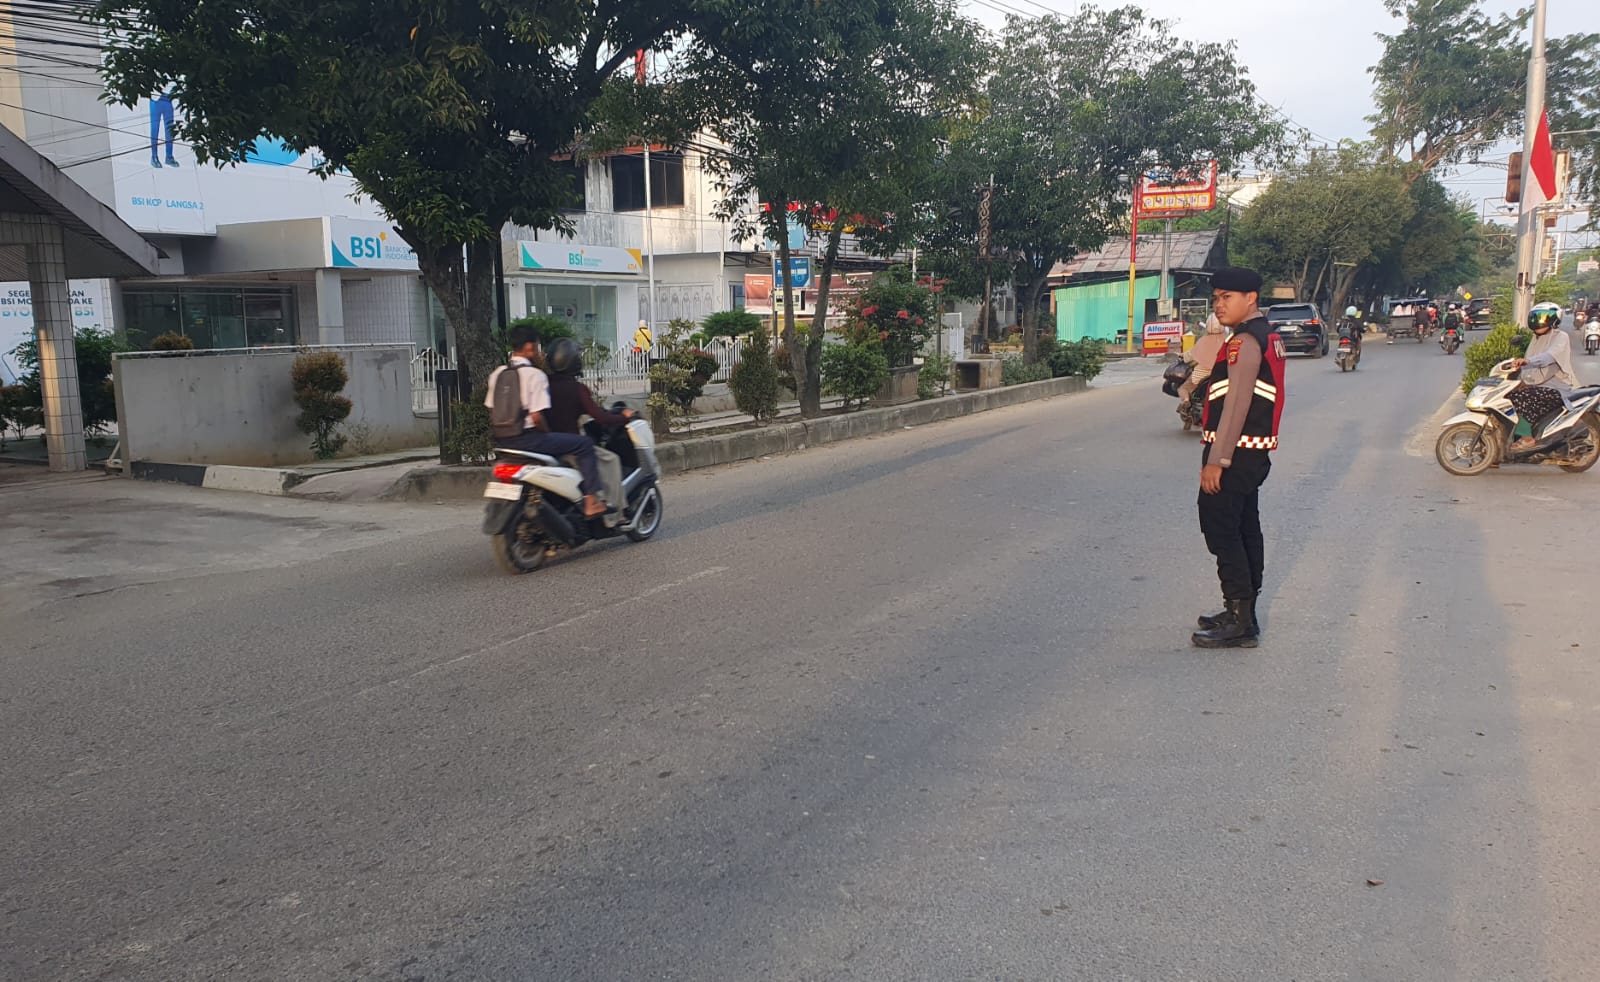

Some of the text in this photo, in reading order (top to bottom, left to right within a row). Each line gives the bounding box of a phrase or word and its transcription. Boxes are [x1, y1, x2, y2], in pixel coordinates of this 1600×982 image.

[132, 197, 144, 205] BSI
[146, 198, 161, 206] KCP
[166, 200, 197, 209] LANGSA
[351, 236, 381, 258] BSI
[569, 253, 583, 265] BSI
[1147, 324, 1181, 332] Alfamart
